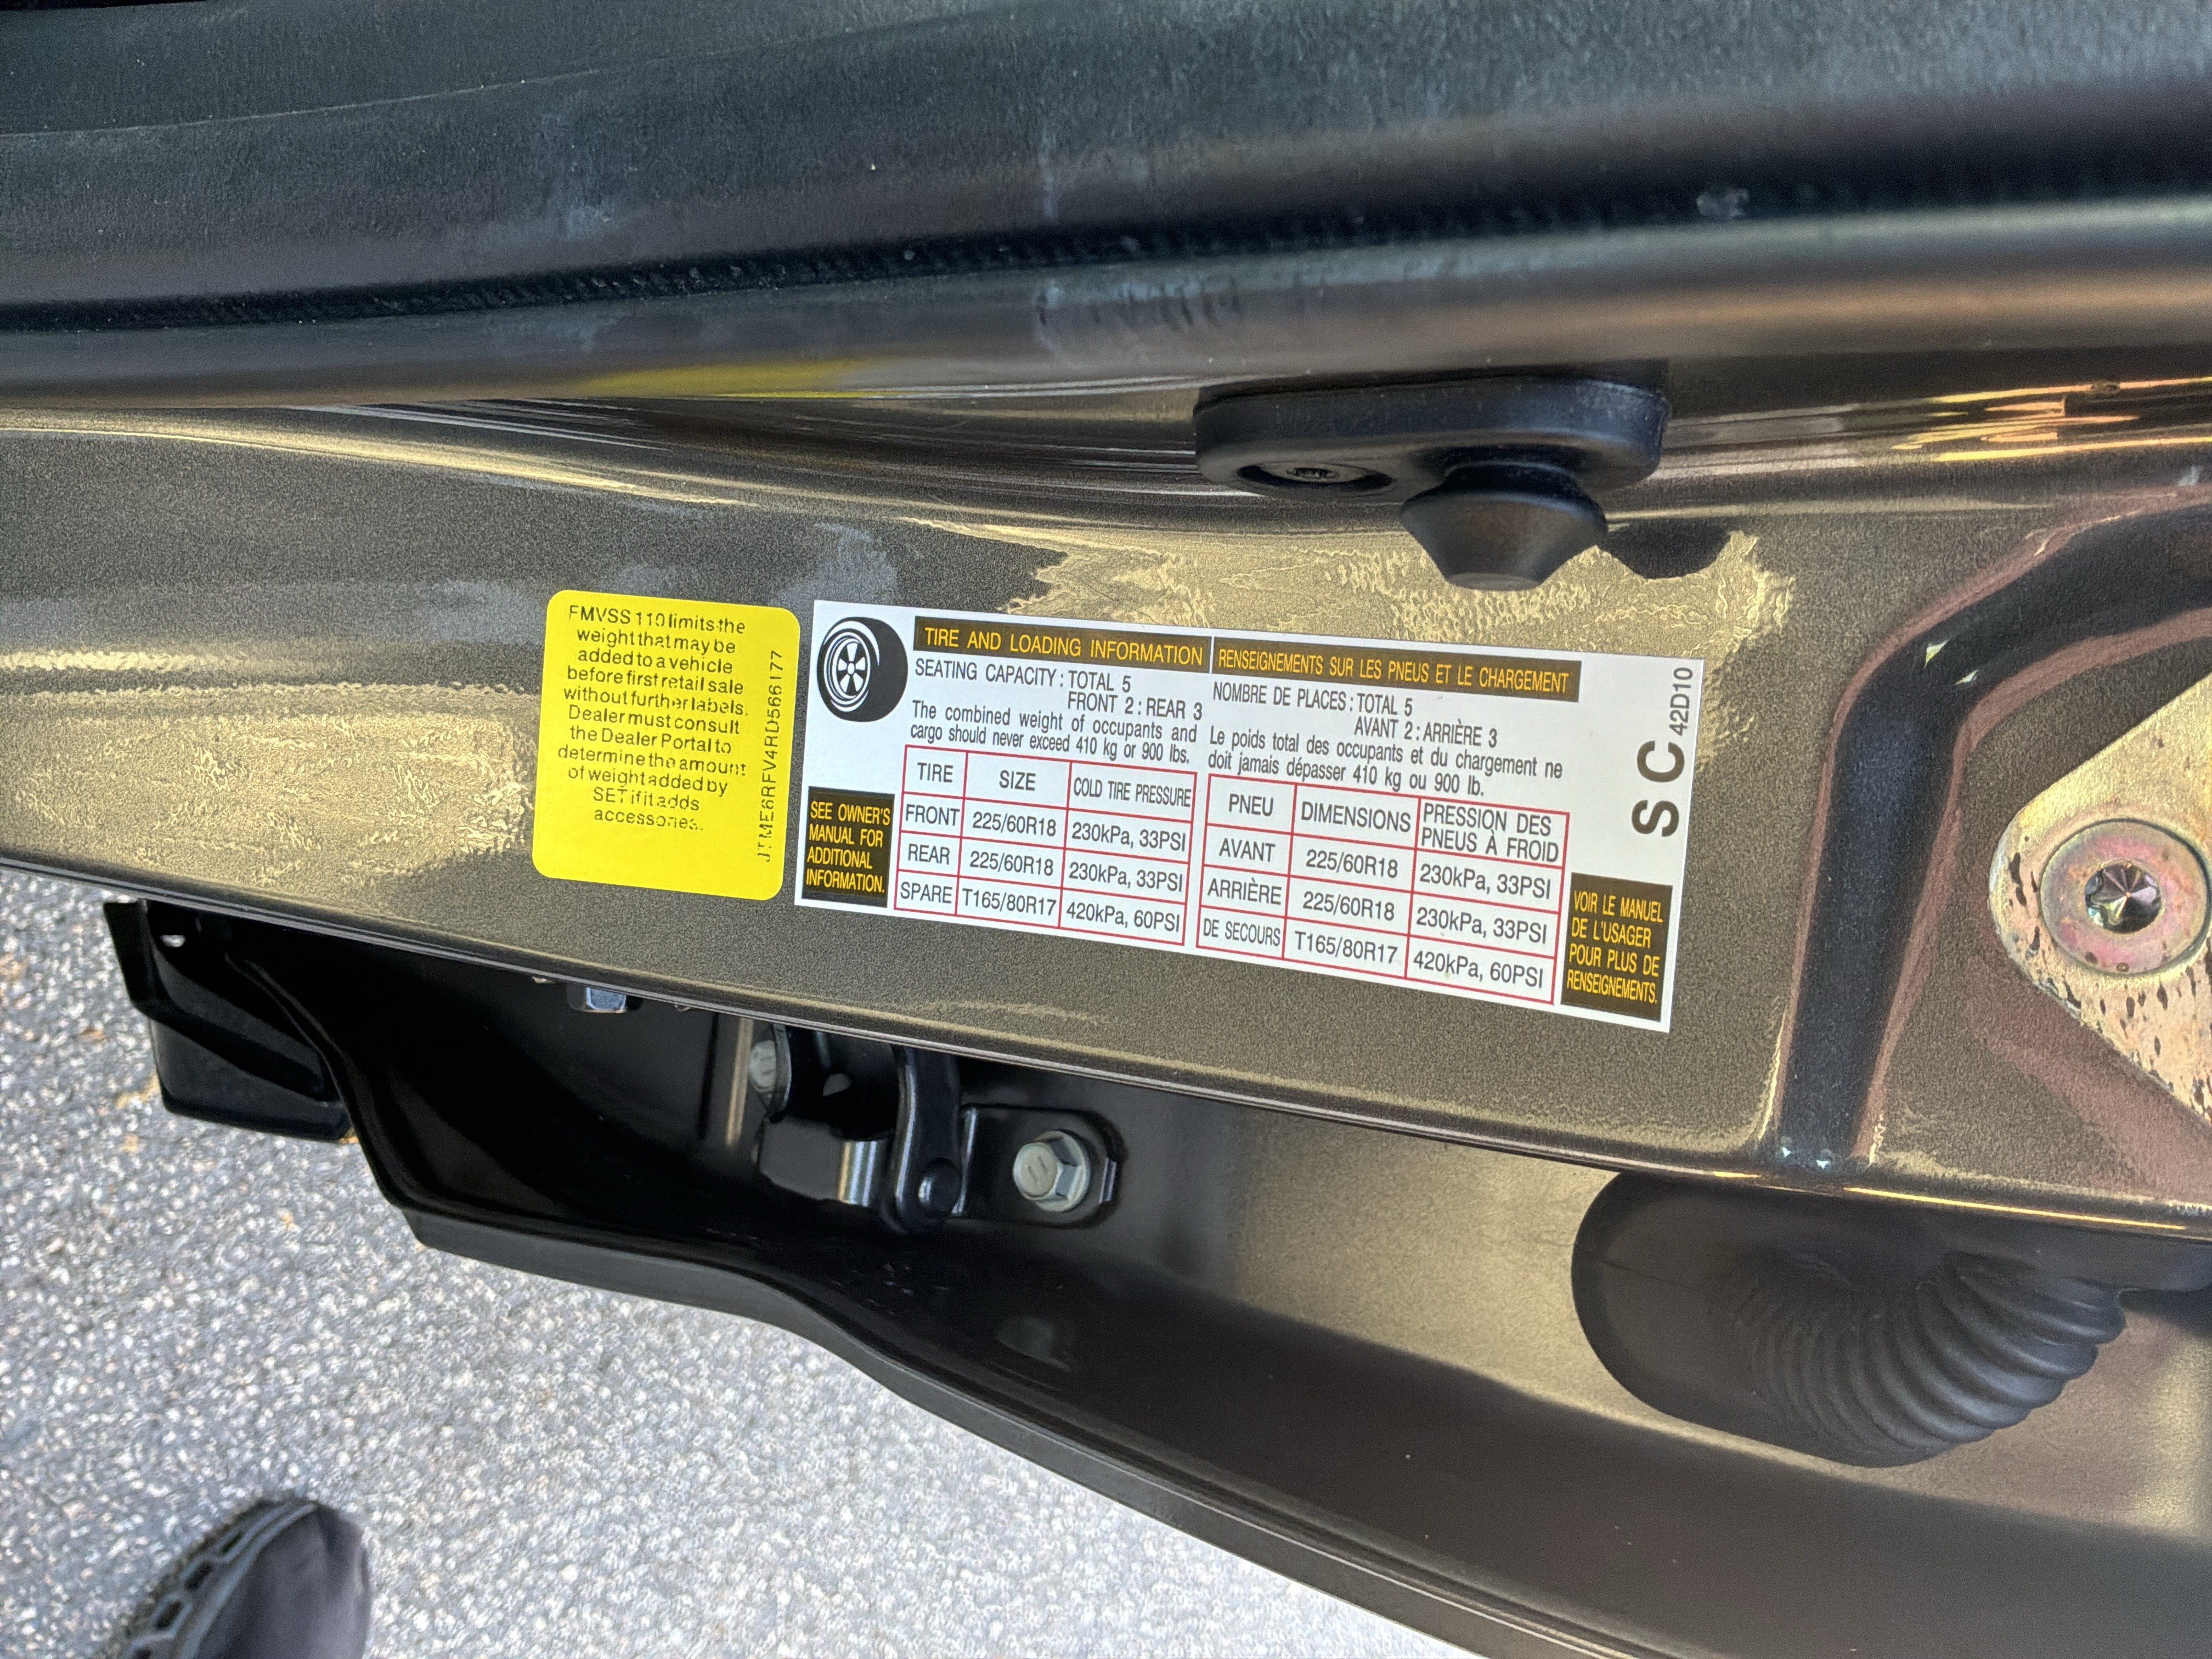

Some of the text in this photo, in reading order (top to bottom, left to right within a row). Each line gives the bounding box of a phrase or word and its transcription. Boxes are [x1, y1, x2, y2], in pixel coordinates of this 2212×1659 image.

[569, 605, 746, 634] FMVSS 110 limits the
[577, 629, 736, 656] weight that may be
[924, 627, 1203, 666] TIRE AND LOADING INFORMATION
[578, 647, 733, 674] added to a vehicle
[915, 658, 978, 680] SEATING
[1068, 670, 1115, 691] TOTAL
[1122, 675, 1131, 693] 5
[1217, 648, 1571, 694] RENSEIGNEMENTS SUR LES PNEUS ET LE CHARGEMENT
[567, 664, 743, 695] before first retail sale
[563, 687, 748, 716] without further labels.
[1068, 691, 1118, 713] FRONT
[1146, 697, 1186, 719] REAR
[1193, 702, 1203, 721] 3
[1213, 681, 1267, 704] NOMBRE
[1273, 686, 1291, 706] DE
[1357, 692, 1398, 715] TOTAL
[1404, 698, 1413, 717] 5
[1669, 667, 1693, 736] 42D10
[569, 704, 740, 735] Dealer must consult
[912, 699, 1197, 743] The combined weight of occupants and
[1353, 716, 1399, 738] AVANT
[1423, 719, 1482, 747] ARRIÈRE
[1488, 728, 1497, 748] 3
[569, 725, 731, 754] the Dealer Portal to
[910, 724, 1189, 764] cargo should never exceed 410 kg or 900 lbs.
[1210, 725, 1562, 779] Le poids total des occupants et du chargement ne
[558, 744, 747, 776] determine the amount
[917, 762, 953, 783] TIRE
[1208, 749, 1484, 796] doit jamais dépasser 410 kg ou 900 lb.
[568, 765, 728, 798] of weight added by
[999, 770, 1036, 791] SIZE
[1074, 777, 1192, 808] COLD TIRE PRESSURE
[592, 786, 699, 811] SET if it adds
[810, 800, 891, 826] SEE OWNER'S
[1228, 793, 1274, 817] PNEU
[594, 804, 703, 831] accessories.
[905, 804, 961, 826] FRONT
[972, 811, 1056, 837] 225/60R18
[1301, 801, 1411, 833] DIMENSIONS
[1423, 803, 1551, 837] PRESSION DES
[809, 823, 884, 848] MANUAL FOR
[1071, 822, 1186, 852] 230kPa, 33PSI
[1218, 838, 1276, 862] AVANT
[1421, 827, 1559, 862] PNEUS À FROID
[806, 845, 873, 870] ADDITIONAL
[908, 843, 950, 865] REAR
[969, 850, 1053, 876] 225/60R18
[1306, 849, 1398, 878] 225/60R18
[806, 868, 885, 893] INFORMATION.
[900, 881, 953, 904] SPARE
[1069, 861, 1183, 893] 230kPa, 33PSI
[1207, 877, 1282, 905] ARRIÈRE
[1420, 864, 1551, 899] 230kPa, 33PSI
[962, 888, 1057, 916] T165/80R17
[1066, 901, 1180, 933] 420kPa, 60PSI
[1302, 891, 1395, 921] 225/60R18
[1574, 890, 1663, 923] VOIR LE MANUEL
[1203, 918, 1280, 946] DE SECOURS
[1417, 907, 1547, 944] 230kPa, 33PSI
[1571, 916, 1652, 949] DE L'USAGER
[1295, 930, 1398, 964] T165/80R17
[1568, 943, 1660, 978] POUR PLUS DE
[1413, 950, 1543, 988] 420kPa, 60PSI
[1566, 968, 1658, 1004] RENSEIGNEMENTS.
